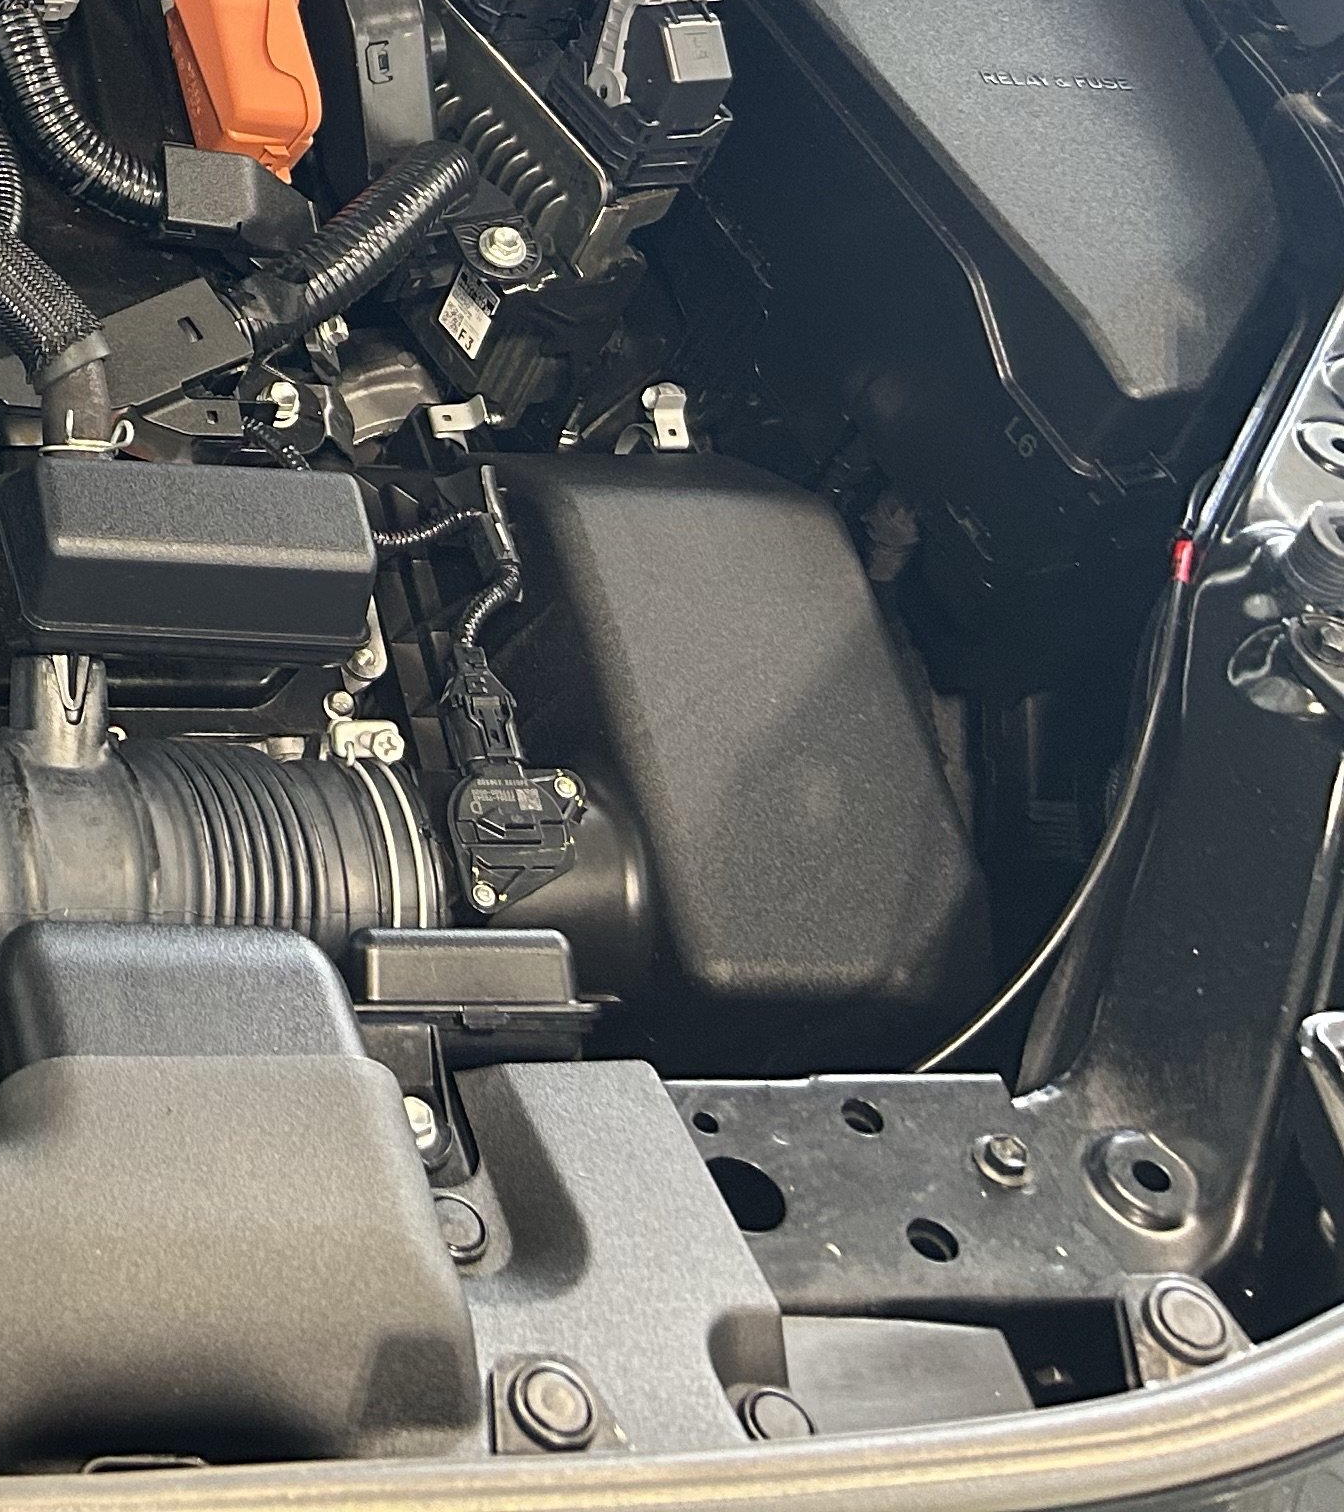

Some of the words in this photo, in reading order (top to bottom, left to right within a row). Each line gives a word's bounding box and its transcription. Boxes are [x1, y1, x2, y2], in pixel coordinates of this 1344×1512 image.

[978, 69, 1049, 88] RELAY
[1073, 74, 1133, 92] FUSE
[1004, 416, 1038, 458] L6
